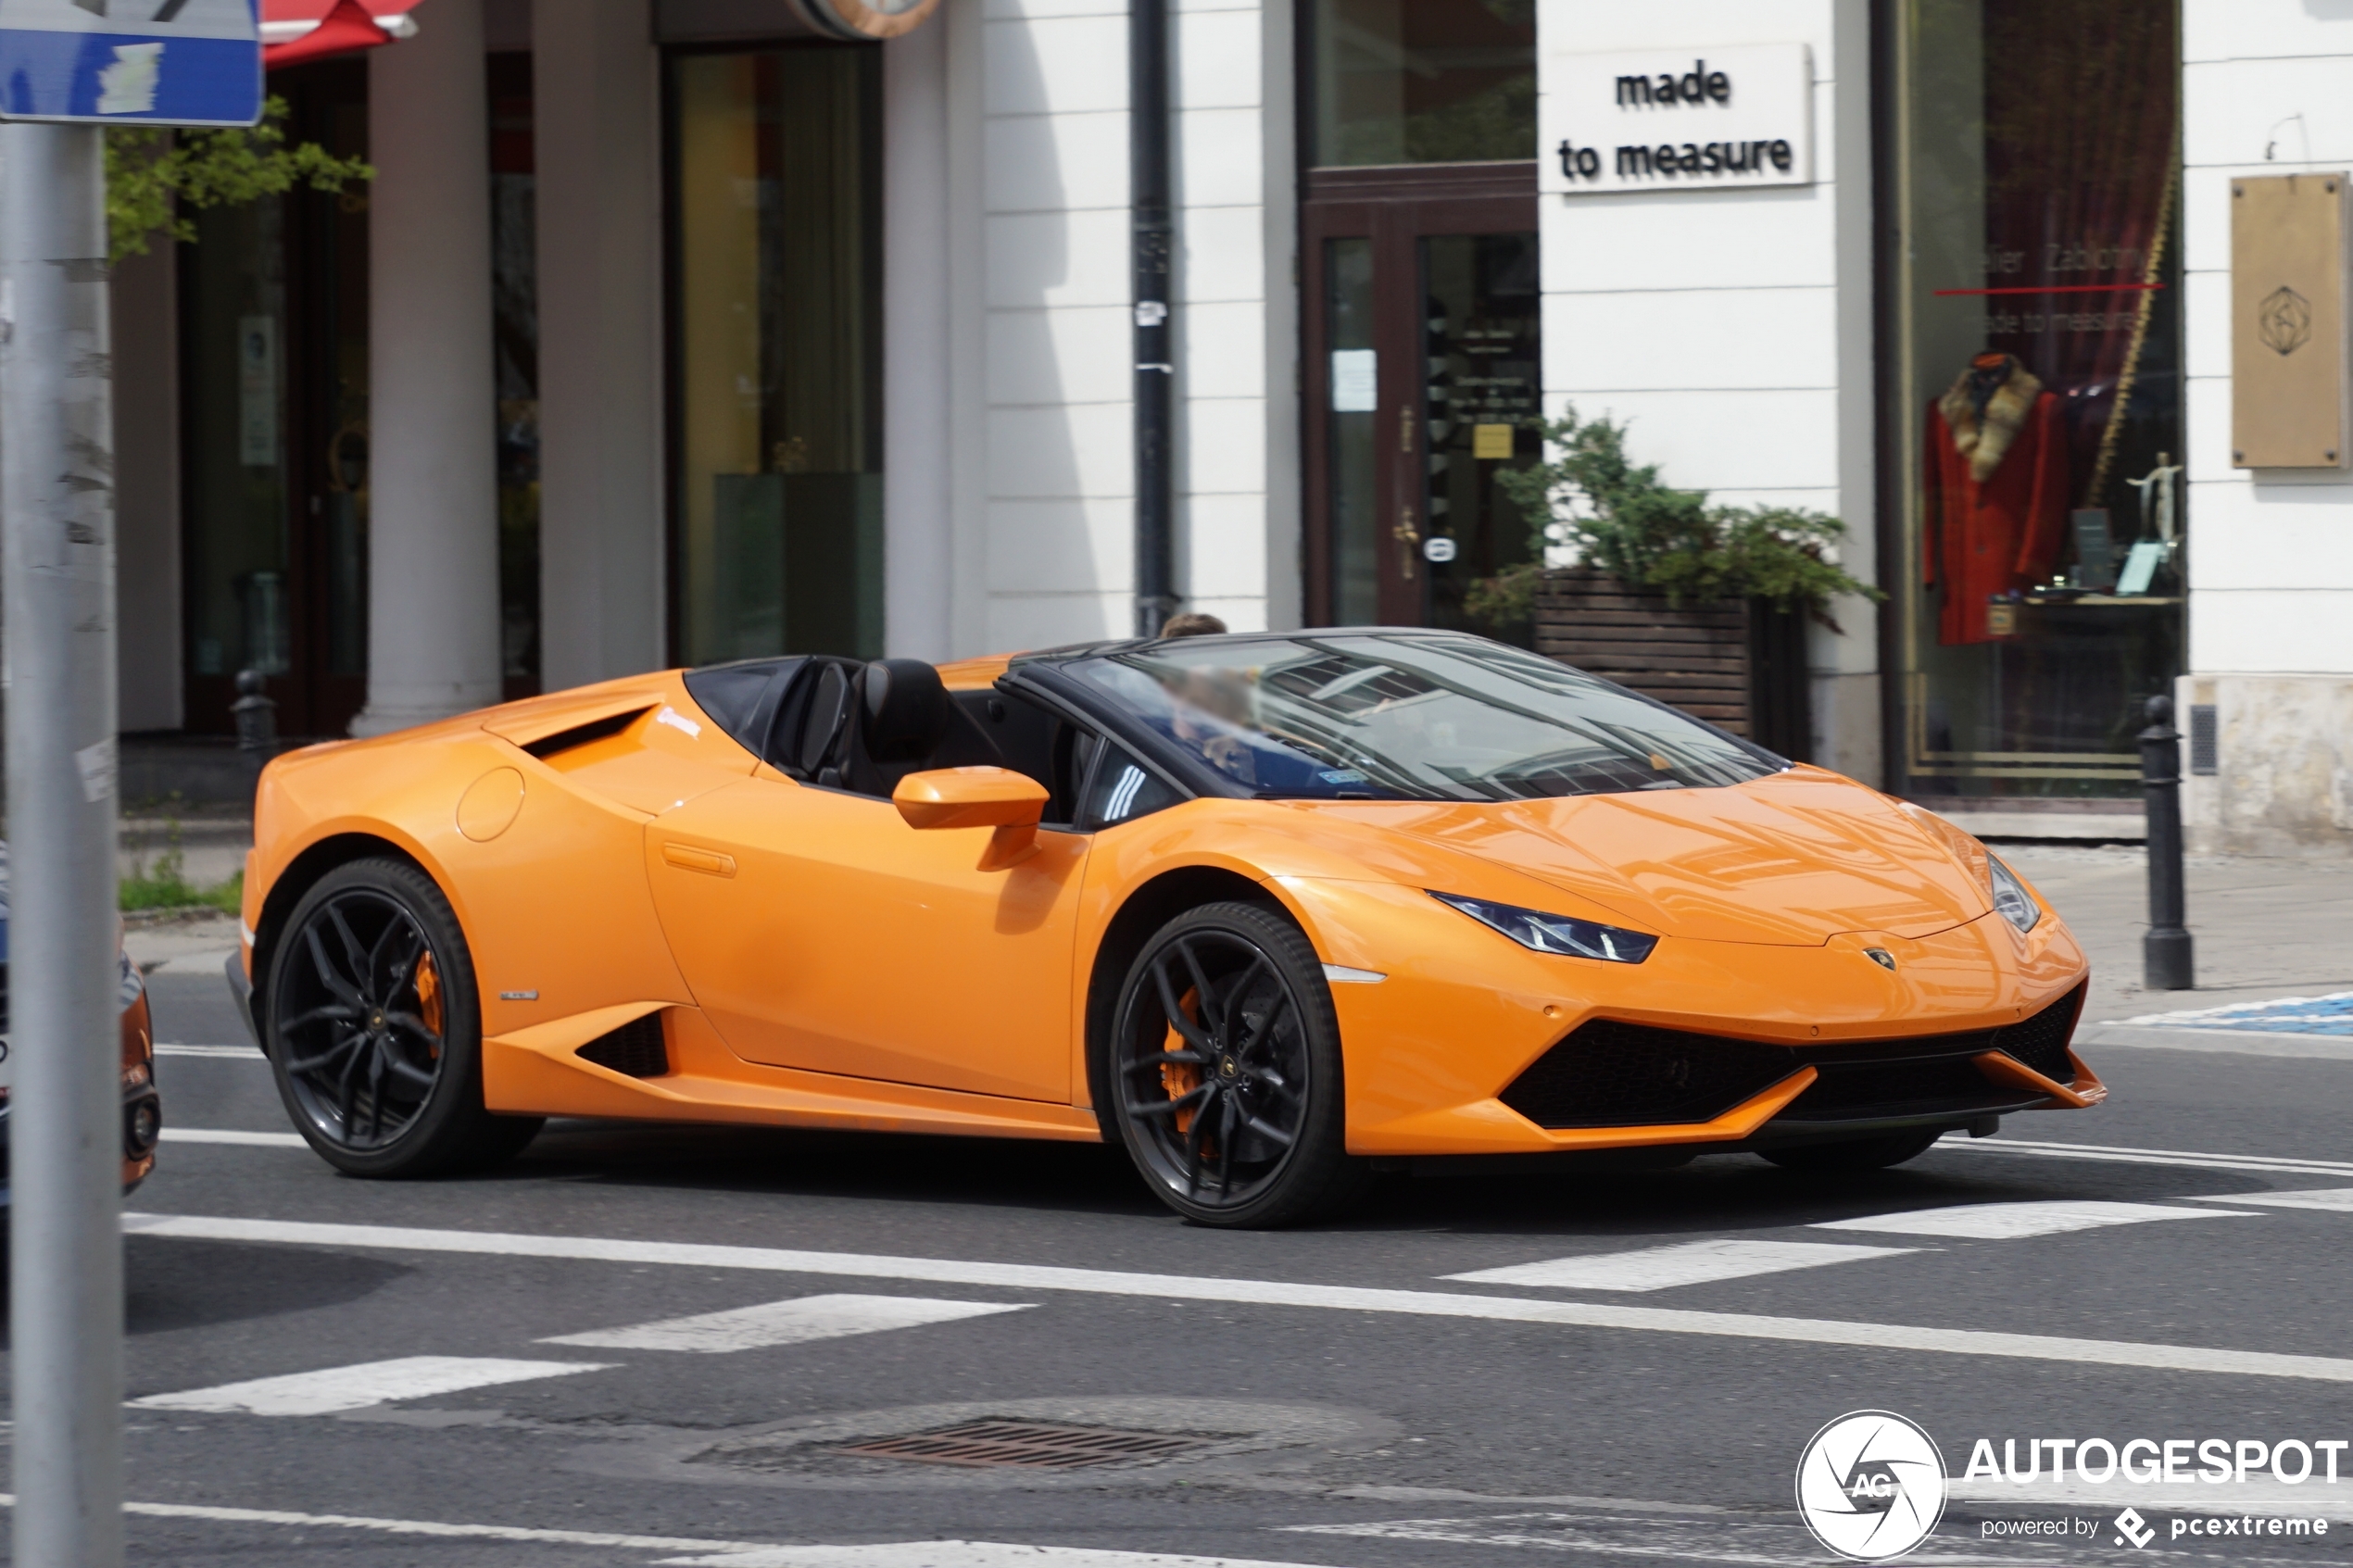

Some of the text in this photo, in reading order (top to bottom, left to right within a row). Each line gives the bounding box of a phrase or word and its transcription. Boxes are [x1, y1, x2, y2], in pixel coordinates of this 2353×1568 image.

[1616, 59, 1730, 107] made
[1557, 139, 1793, 181] to measure
